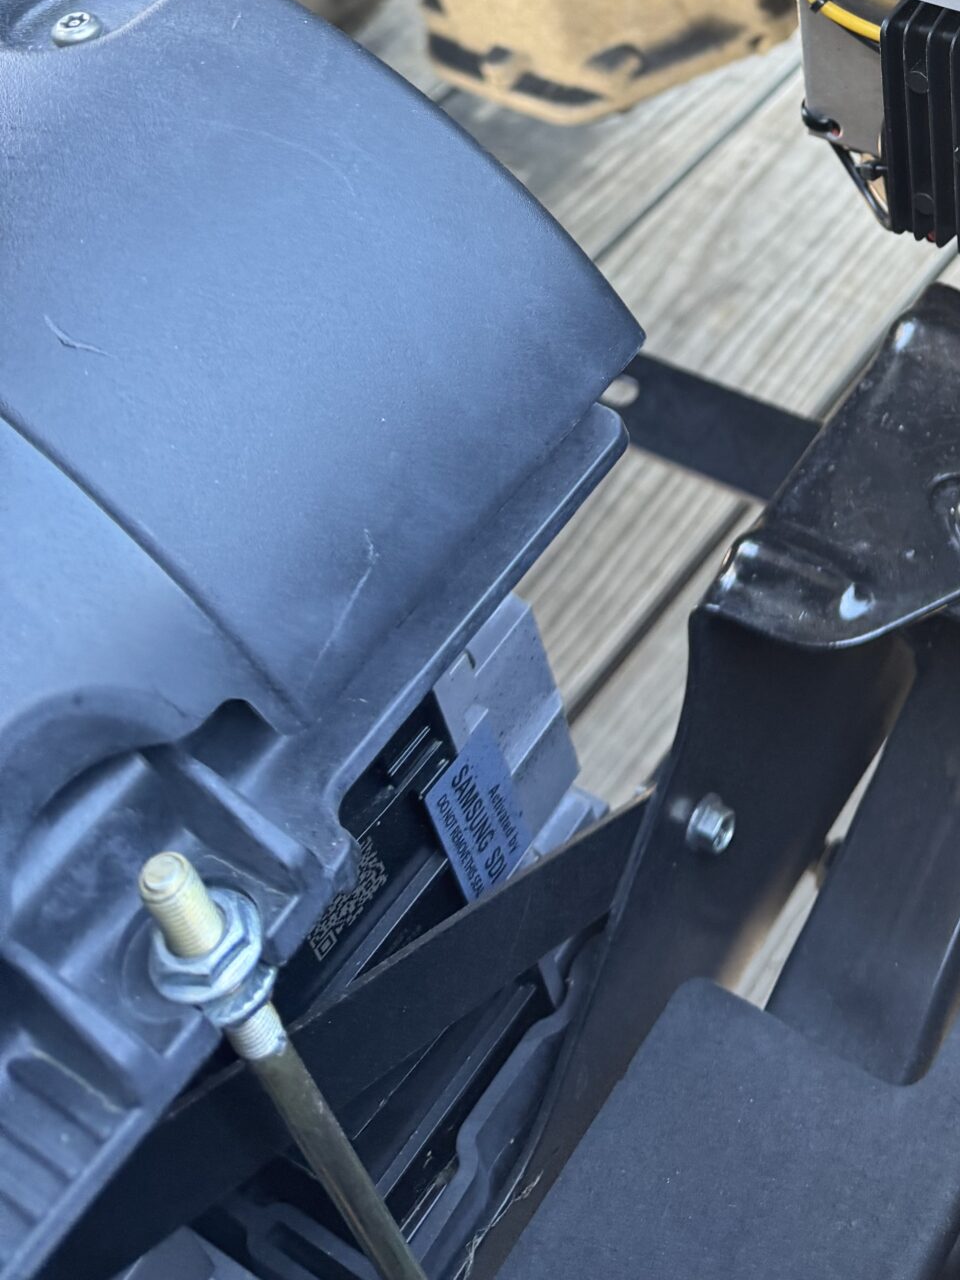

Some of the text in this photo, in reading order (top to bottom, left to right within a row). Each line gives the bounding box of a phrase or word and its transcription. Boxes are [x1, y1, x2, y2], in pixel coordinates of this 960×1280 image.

[437, 793, 450, 814] DO
[443, 807, 456, 830] NOT
[488, 783, 520, 854] Activated by
[451, 764, 507, 885] SAMSUNG SDI
[450, 826, 471, 864] REMOVE
